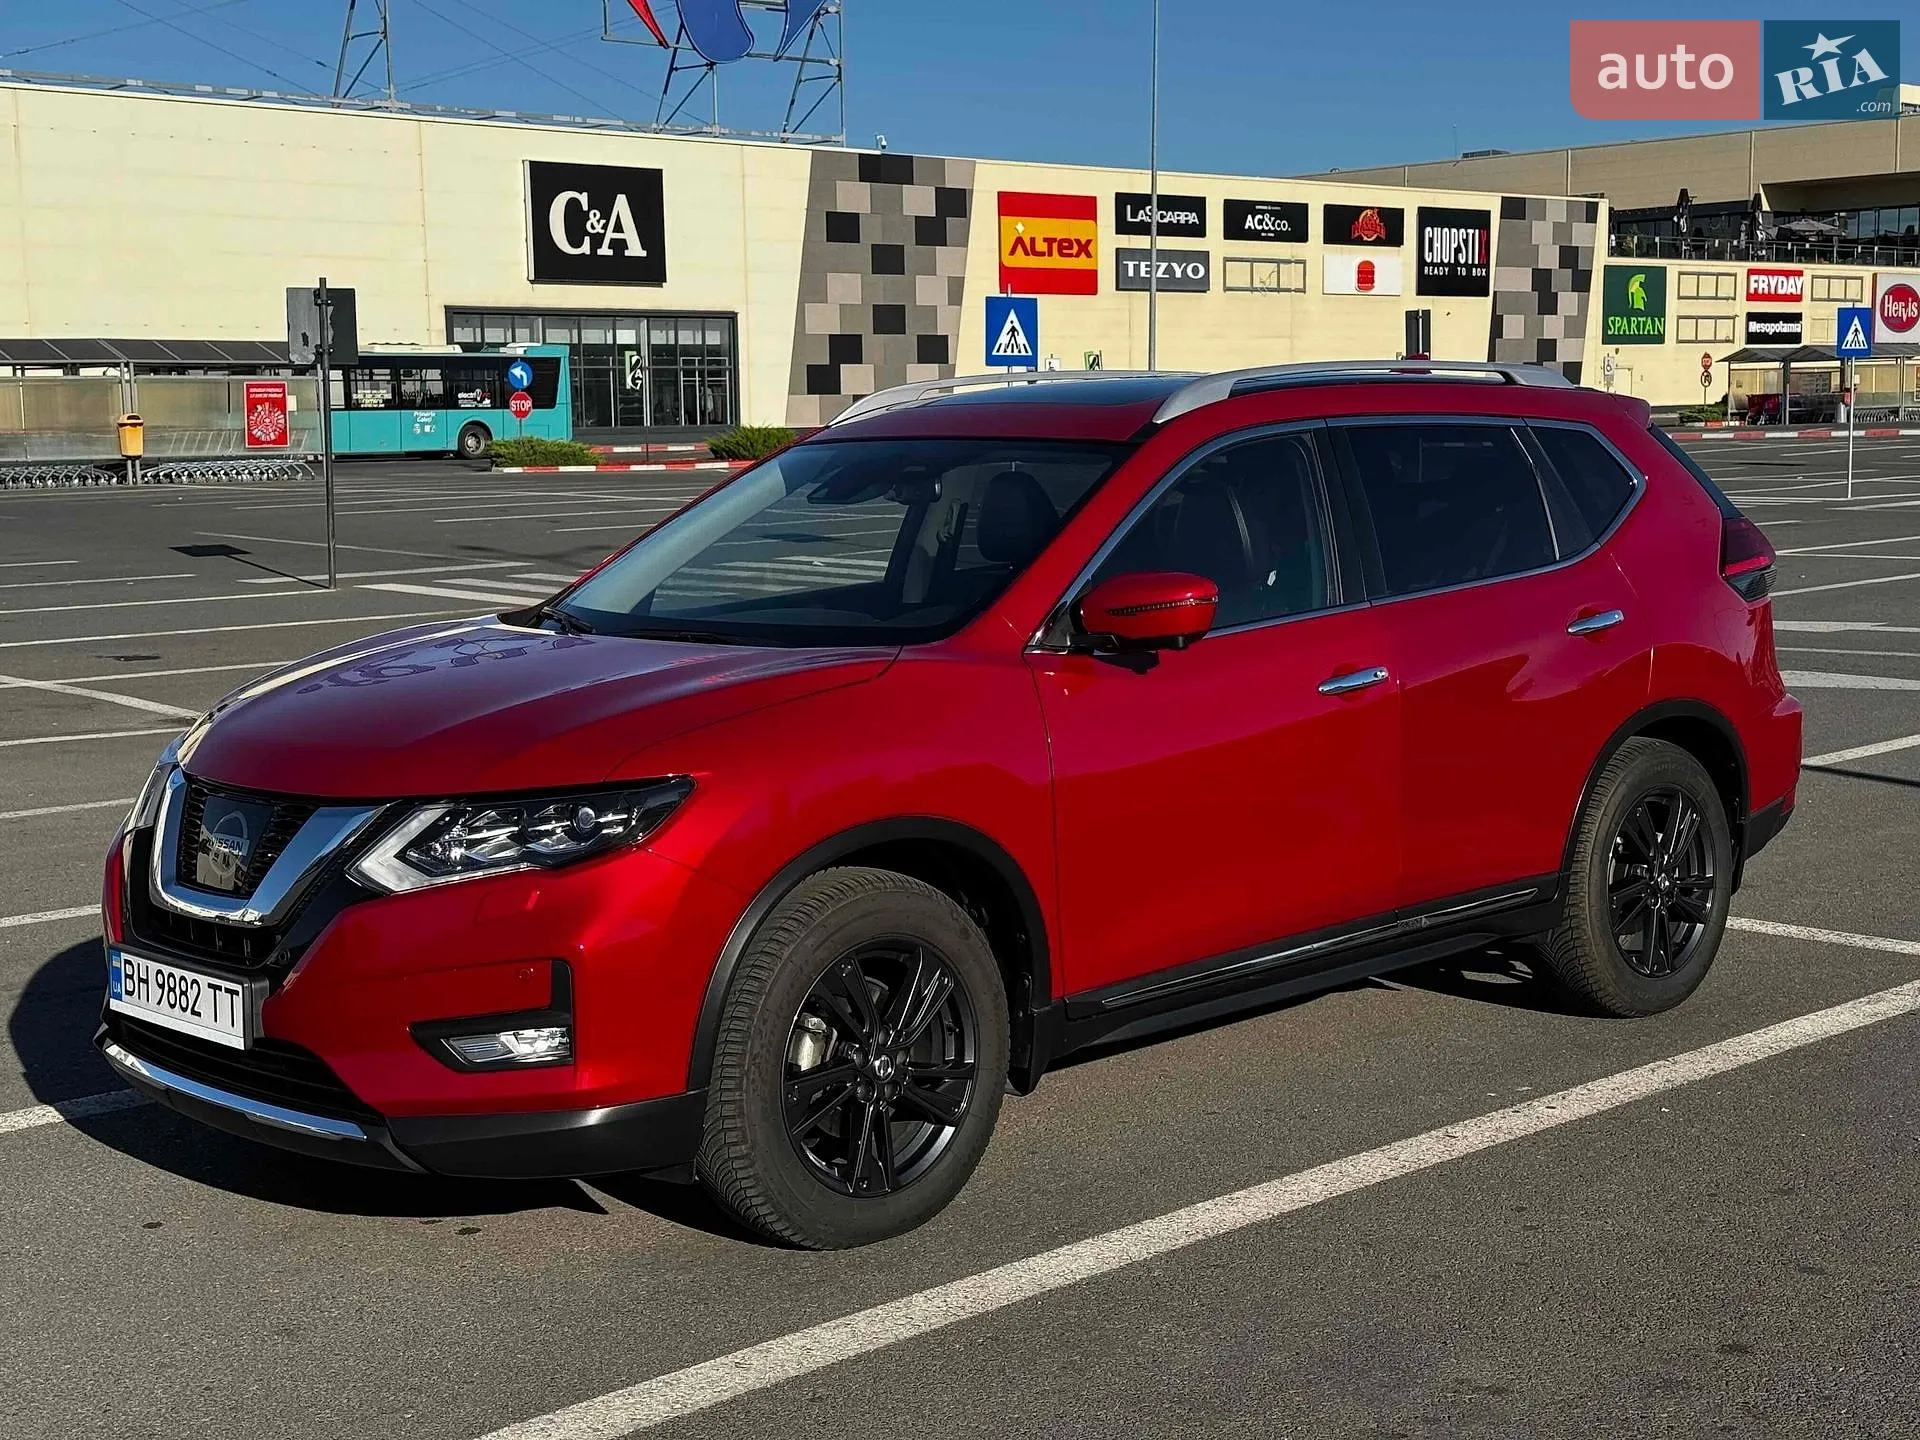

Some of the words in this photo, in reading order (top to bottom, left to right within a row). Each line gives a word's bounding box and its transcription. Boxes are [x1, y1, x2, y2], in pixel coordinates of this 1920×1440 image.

[549, 190, 648, 258] C&A
[1424, 226, 1487, 265] CHOPSTIX
[1122, 260, 1206, 280] TEZYO
[1424, 266, 1449, 276] READY
[1457, 266, 1467, 277] TO
[1472, 267, 1487, 277] BOX
[1749, 274, 1804, 296] FRYDAY
[1884, 294, 1919, 323] Hervis
[1607, 315, 1665, 336] SPARTAN
[511, 399, 531, 412] STOP
[123, 957, 150, 1004] BH
[155, 968, 202, 1019] 9882
[207, 982, 240, 1029] TT
